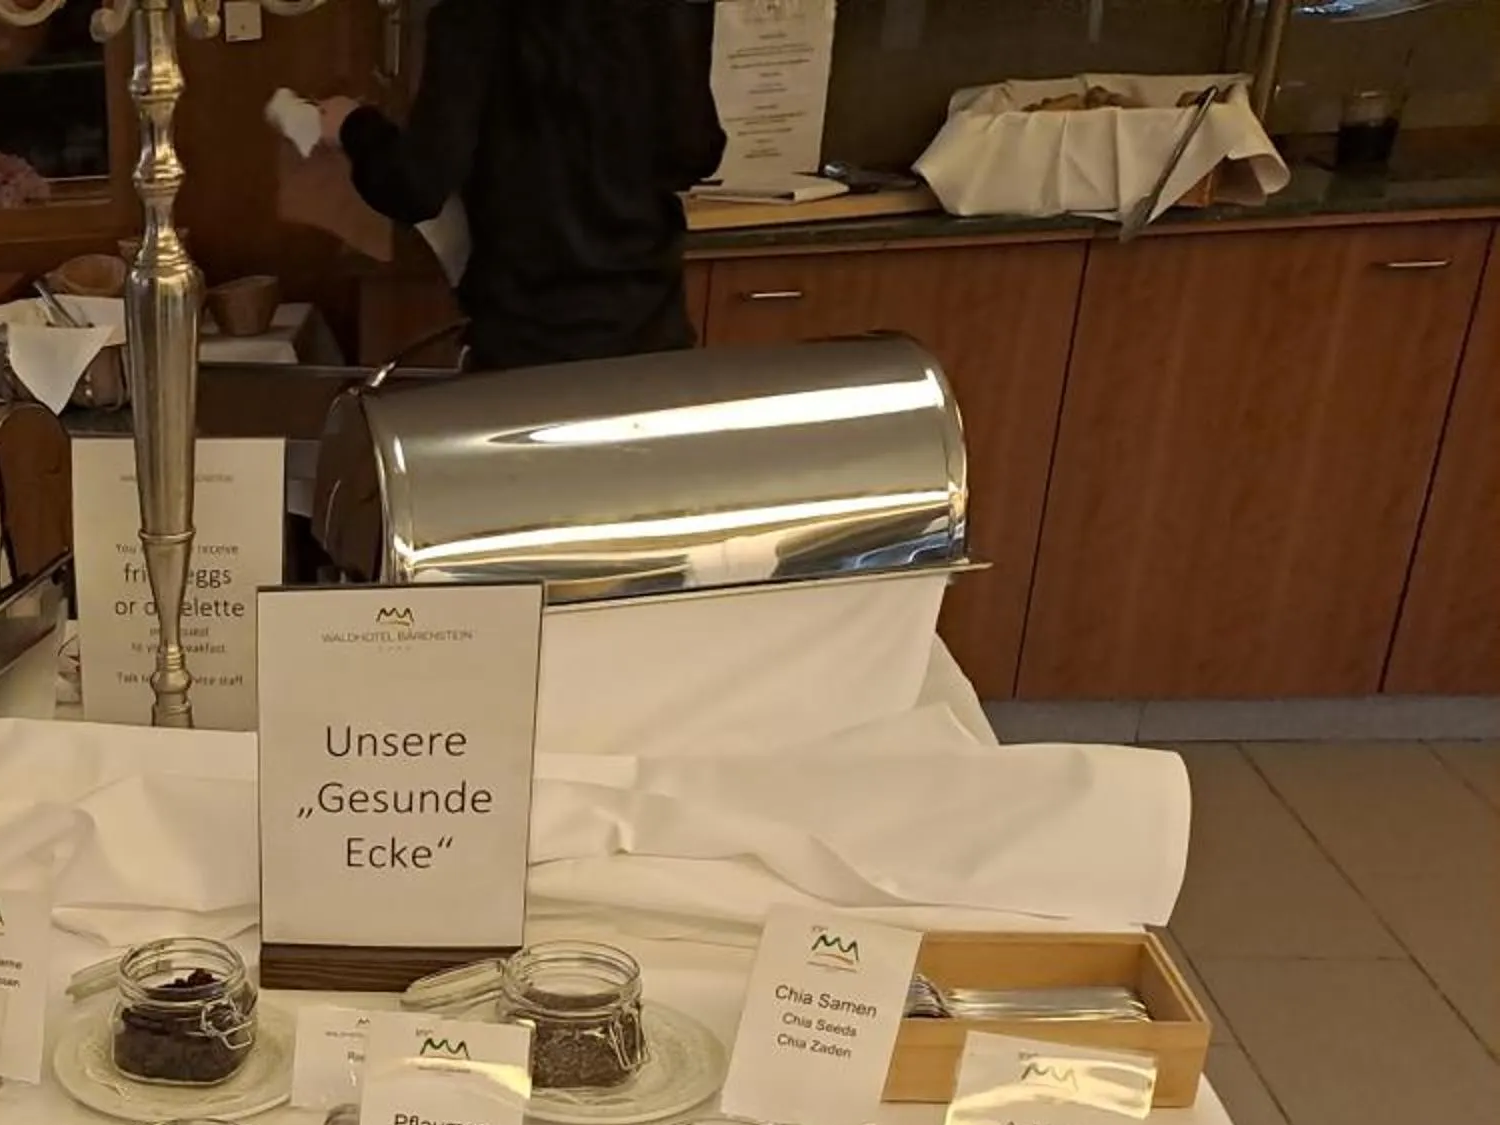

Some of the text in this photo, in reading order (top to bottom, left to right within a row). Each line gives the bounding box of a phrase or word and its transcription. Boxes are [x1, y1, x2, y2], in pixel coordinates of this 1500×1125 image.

[115, 597, 245, 618] or oelette
[326, 724, 467, 757] Unsere
[775, 984, 877, 1019] Chia Samen
[782, 1011, 812, 1029] Chia
[777, 1032, 852, 1058] Chia Zaden
